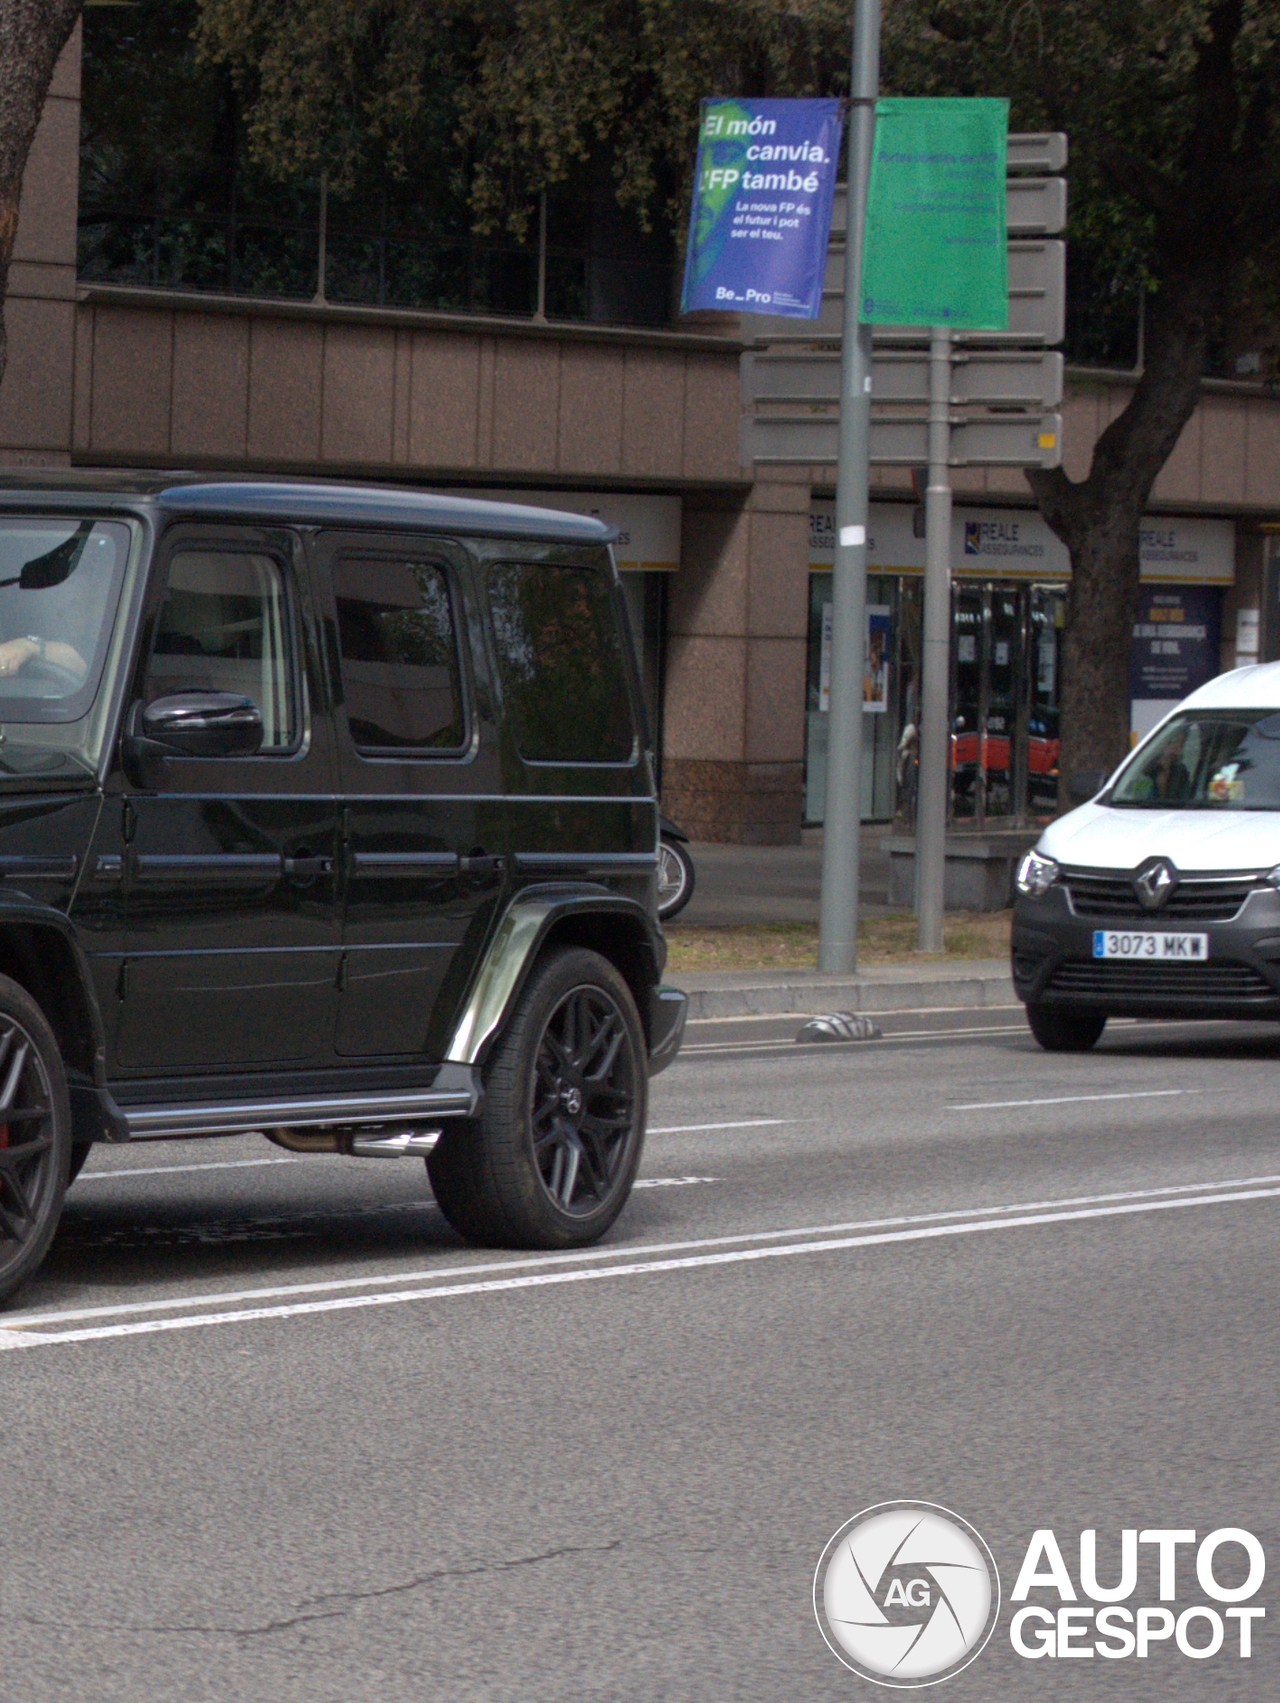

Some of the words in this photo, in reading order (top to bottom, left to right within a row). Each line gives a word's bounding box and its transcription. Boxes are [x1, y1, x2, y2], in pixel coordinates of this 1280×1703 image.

[704, 115, 724, 136] El
[726, 115, 776, 135] món
[746, 140, 830, 163] canvia.
[742, 170, 819, 193] també
[736, 201, 749, 212] La
[750, 203, 777, 212] nova
[779, 202, 795, 213] FP
[733, 214, 744, 225] el
[745, 214, 772, 225] futur
[778, 218, 799, 229] pot
[731, 229, 748, 239] ser
[749, 228, 760, 239] el
[761, 229, 784, 240] teu.
[980, 522, 1020, 542] REALE
[1108, 934, 1156, 956] 3073
[1163, 936, 1201, 957] MKW
